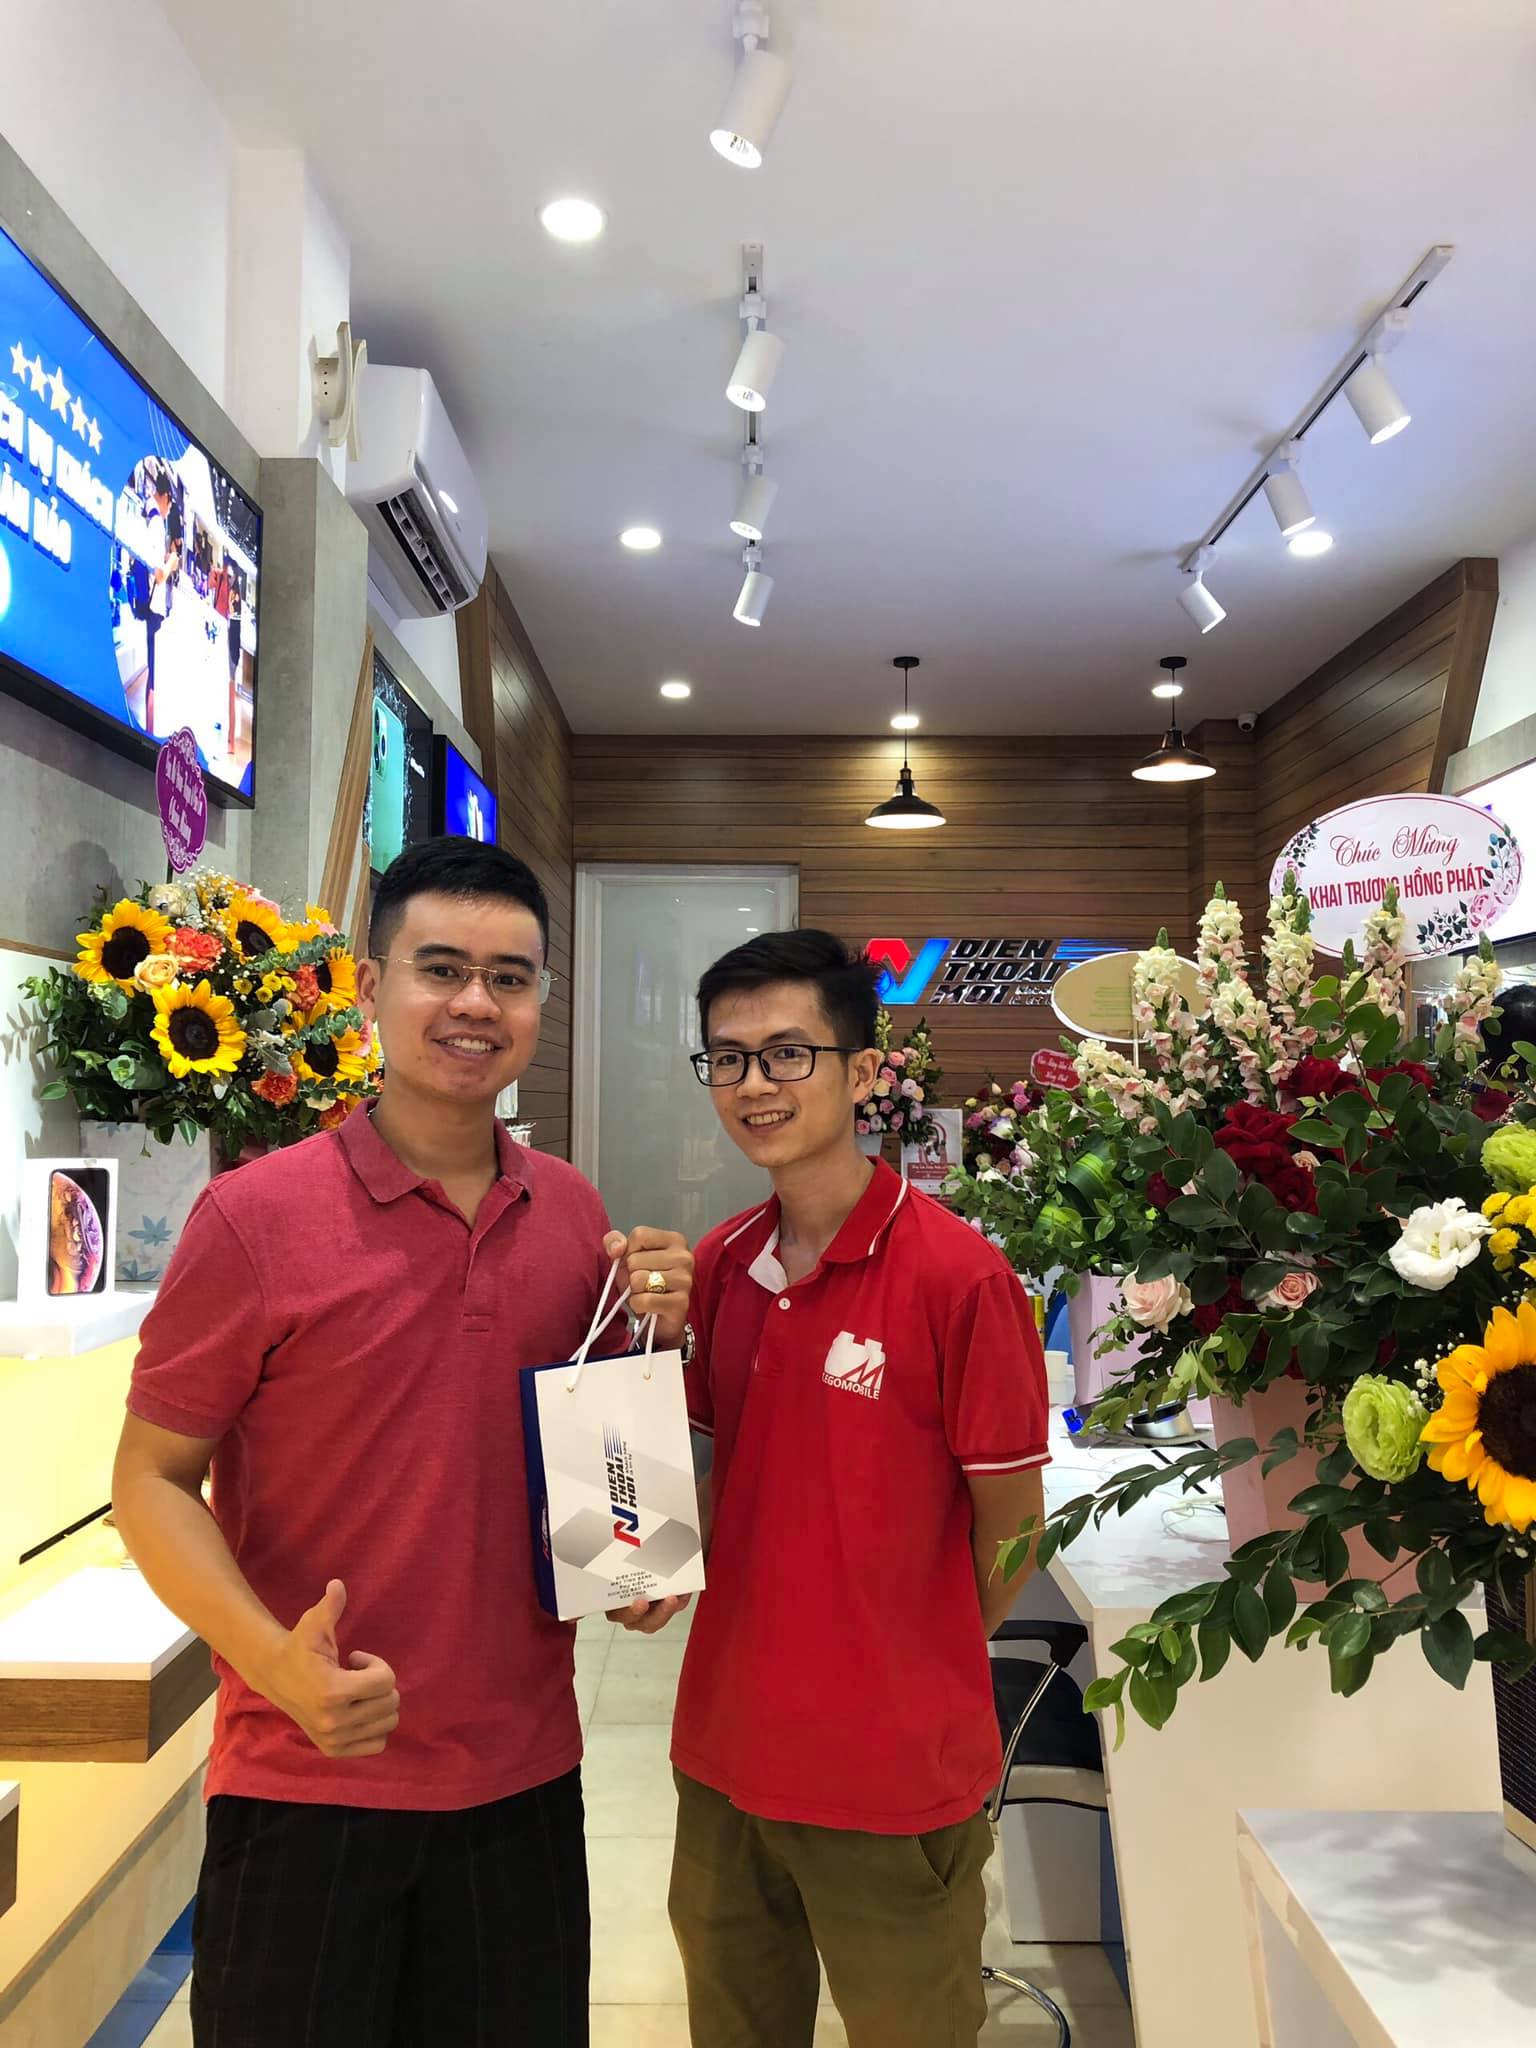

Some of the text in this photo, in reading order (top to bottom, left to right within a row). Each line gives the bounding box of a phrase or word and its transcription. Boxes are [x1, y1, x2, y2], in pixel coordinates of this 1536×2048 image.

[1330, 835, 1381, 867] Chúc
[1309, 882, 1342, 909] KHAI
[1404, 866, 1443, 898] HỒNG
[1447, 863, 1485, 894] PHÁT
[951, 938, 1054, 960] DIEN
[943, 961, 1061, 982] THOAI
[821, 1372, 880, 1400] LEGOMOBILE
[614, 1456, 628, 1505] THOAI
[626, 1475, 638, 1509] MOI
